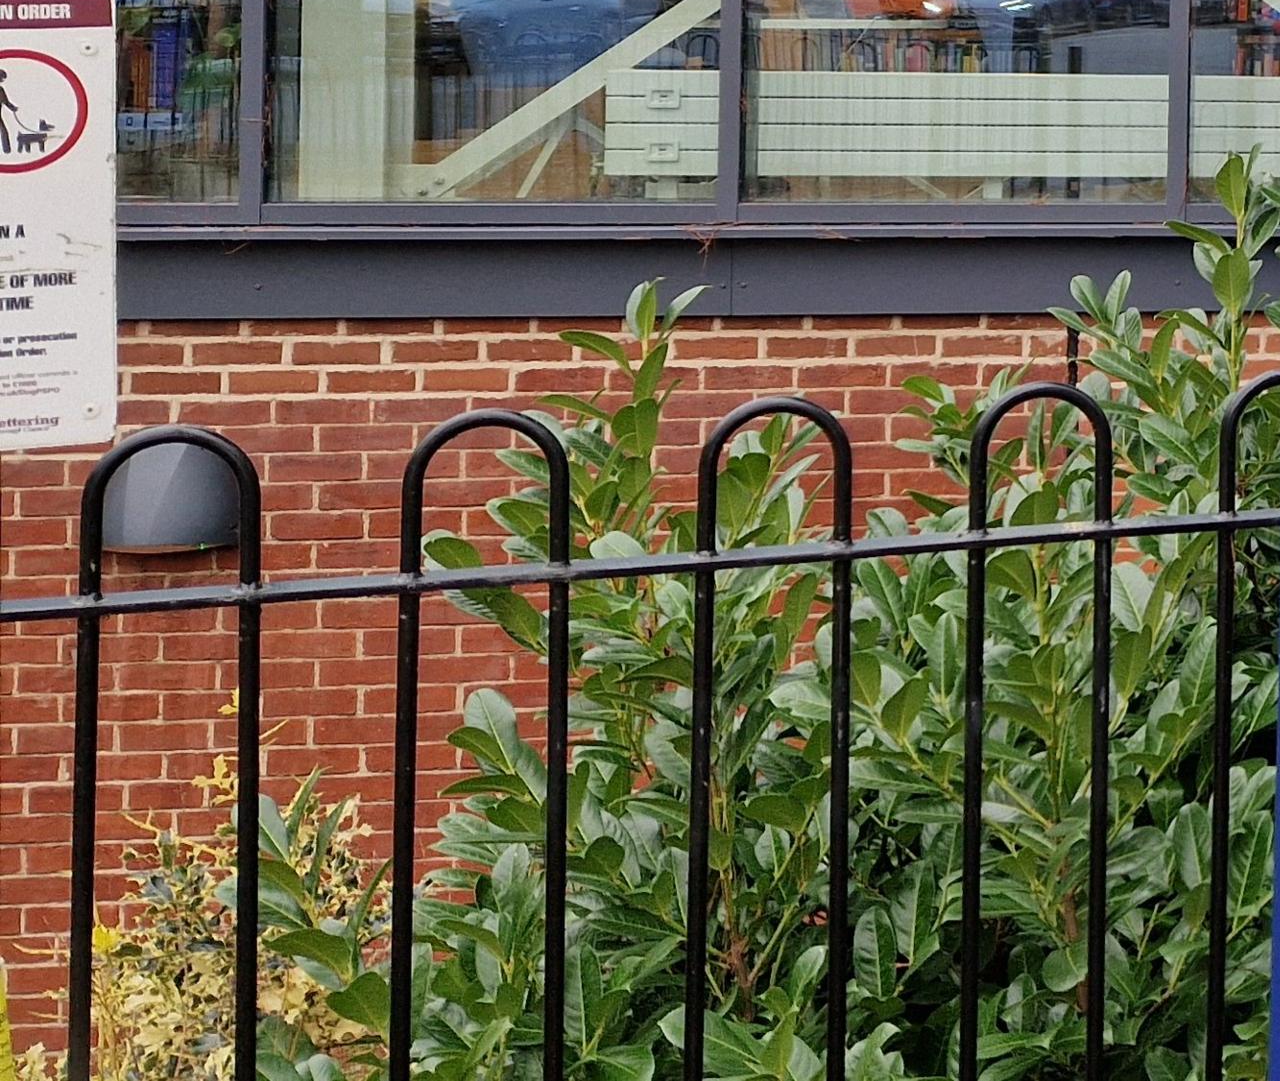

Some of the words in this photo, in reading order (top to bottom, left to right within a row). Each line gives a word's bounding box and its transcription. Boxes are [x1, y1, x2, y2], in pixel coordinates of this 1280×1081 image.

[17, 4, 71, 20] ORDER
[15, 224, 26, 238] A
[10, 274, 28, 288] OF
[33, 272, 77, 287] MORE
